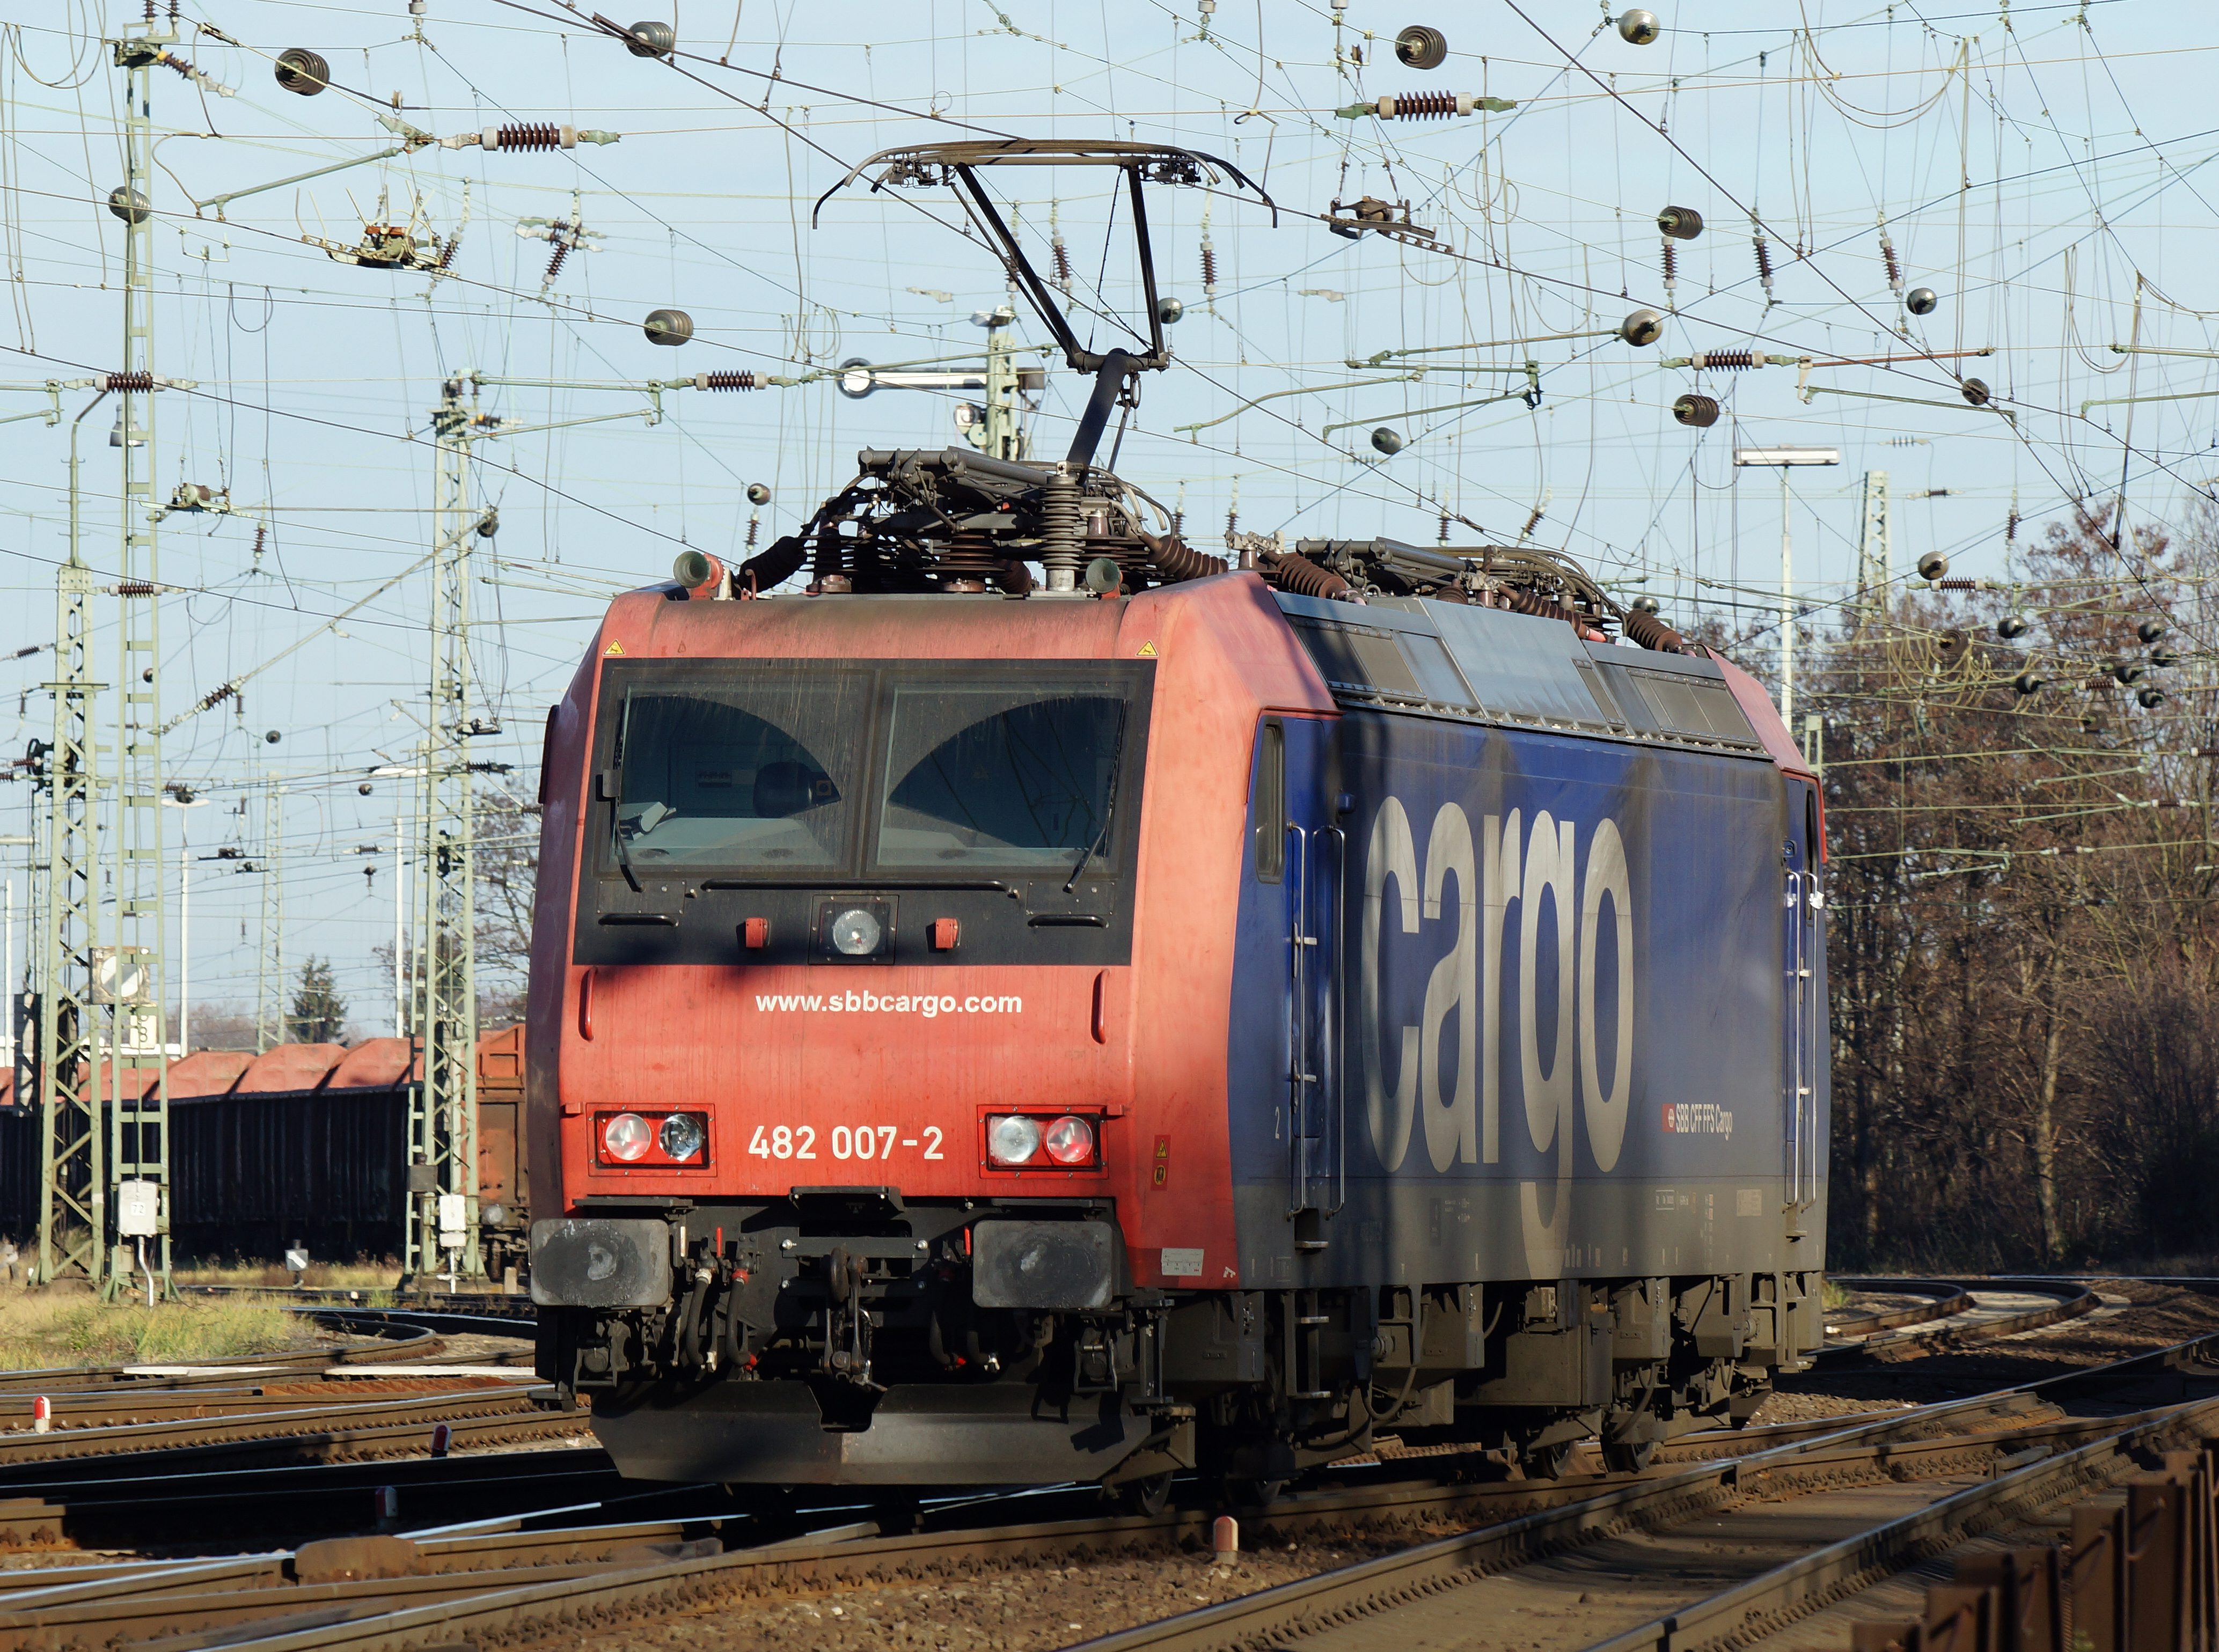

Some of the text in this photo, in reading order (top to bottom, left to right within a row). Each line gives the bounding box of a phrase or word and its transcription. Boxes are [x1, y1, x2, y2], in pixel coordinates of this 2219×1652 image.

[756, 990, 1022, 1018] www.sbbcargo.com
[1361, 796, 1634, 1279] cargo
[1275, 1106, 1280, 1139] 2
[1676, 1103, 1733, 1141] SBB CFF FFS Cargo
[748, 1126, 943, 1159] 482 007-2
[131, 1204, 144, 1214] 72
